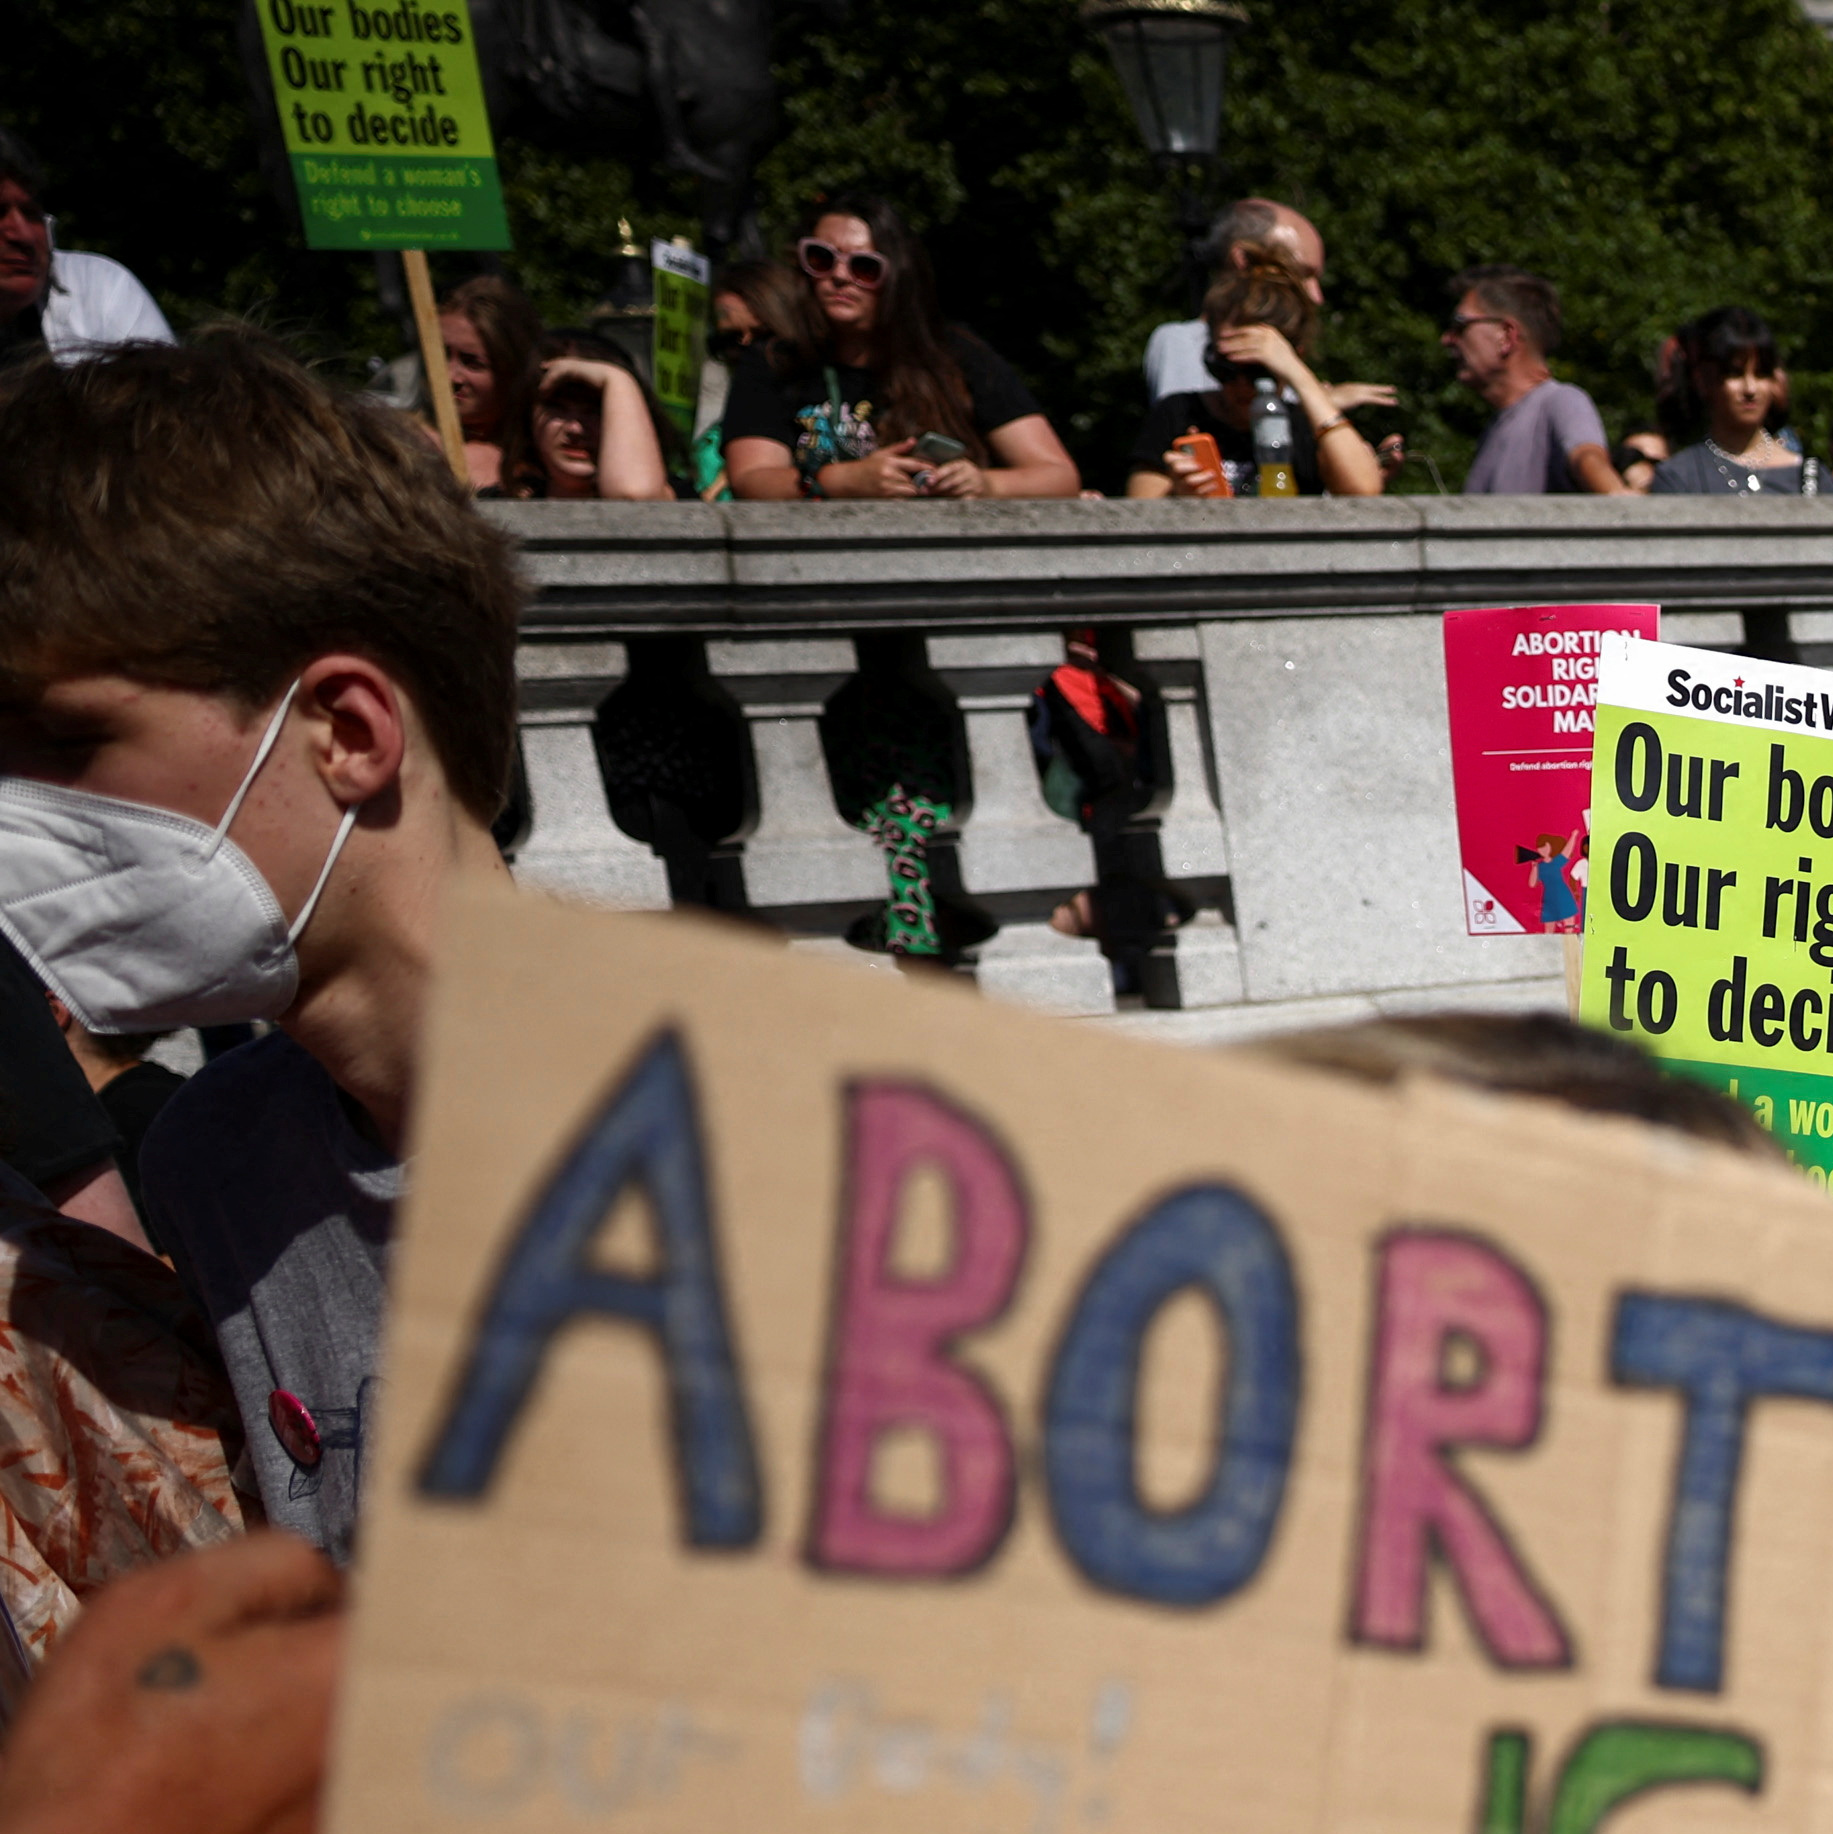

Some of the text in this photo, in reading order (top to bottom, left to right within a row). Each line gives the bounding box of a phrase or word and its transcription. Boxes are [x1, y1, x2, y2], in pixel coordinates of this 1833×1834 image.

[270, 0, 463, 44] Our bodies
[281, 46, 448, 104] Our right
[292, 102, 460, 147] to decide
[1511, 630, 1641, 656] ABORTI
[1552, 657, 1599, 681] RIG
[1502, 683, 1597, 709] SOLIDAR
[1509, 759, 1592, 771] Defend abortion rig
[1615, 721, 1740, 822] Our
[1609, 831, 1737, 932] Our
[1605, 946, 1678, 1035] to
[1754, 1095, 1774, 1130] a
